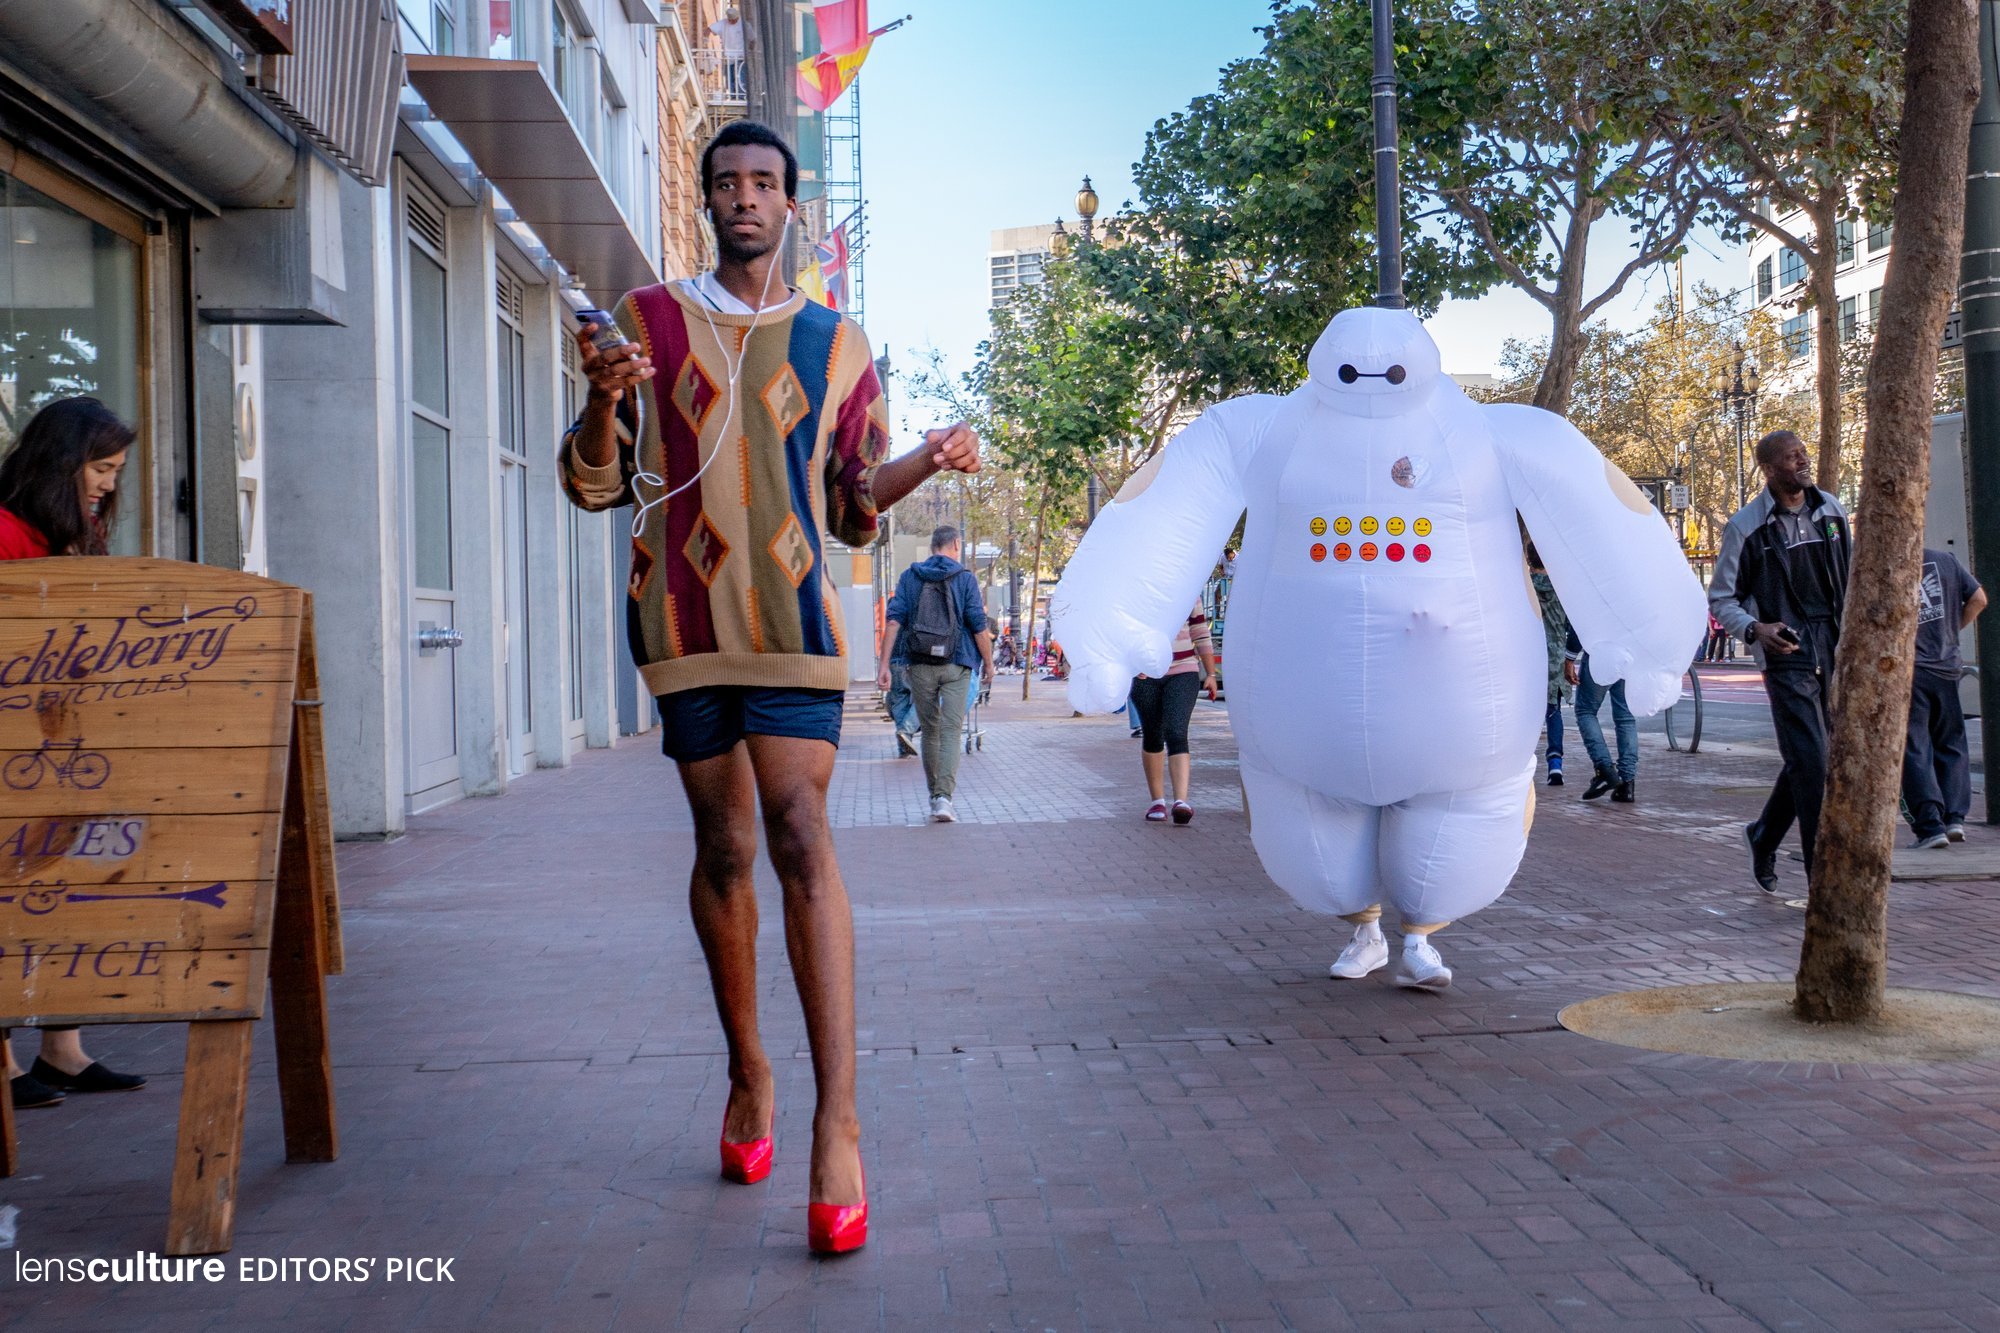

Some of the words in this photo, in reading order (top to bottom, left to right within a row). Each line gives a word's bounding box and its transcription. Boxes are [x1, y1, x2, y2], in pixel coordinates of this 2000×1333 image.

[0, 617, 234, 688] ckleberry
[37, 671, 190, 711] BICYCLES
[21, 879, 68, 915] &
[0, 940, 167, 980] VICE
